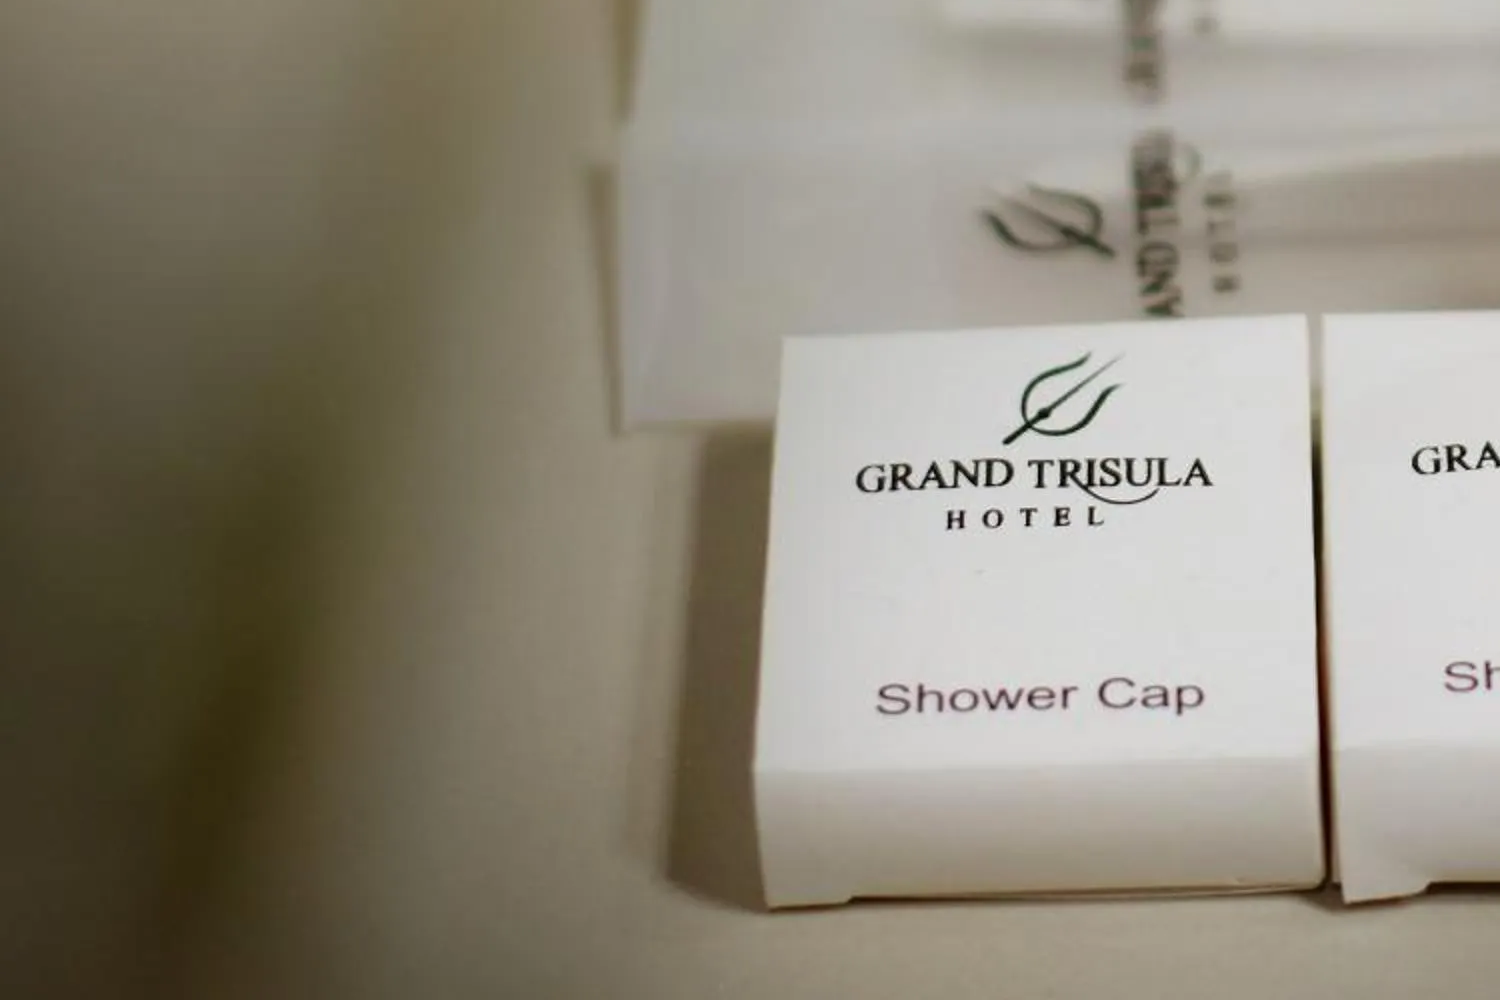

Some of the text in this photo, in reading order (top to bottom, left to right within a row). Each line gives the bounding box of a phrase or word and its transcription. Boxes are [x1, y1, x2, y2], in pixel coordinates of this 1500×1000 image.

[855, 457, 1213, 504] GRAND TRISULA
[946, 506, 1104, 530] HOTEL
[875, 677, 1205, 716] Shower Cap
